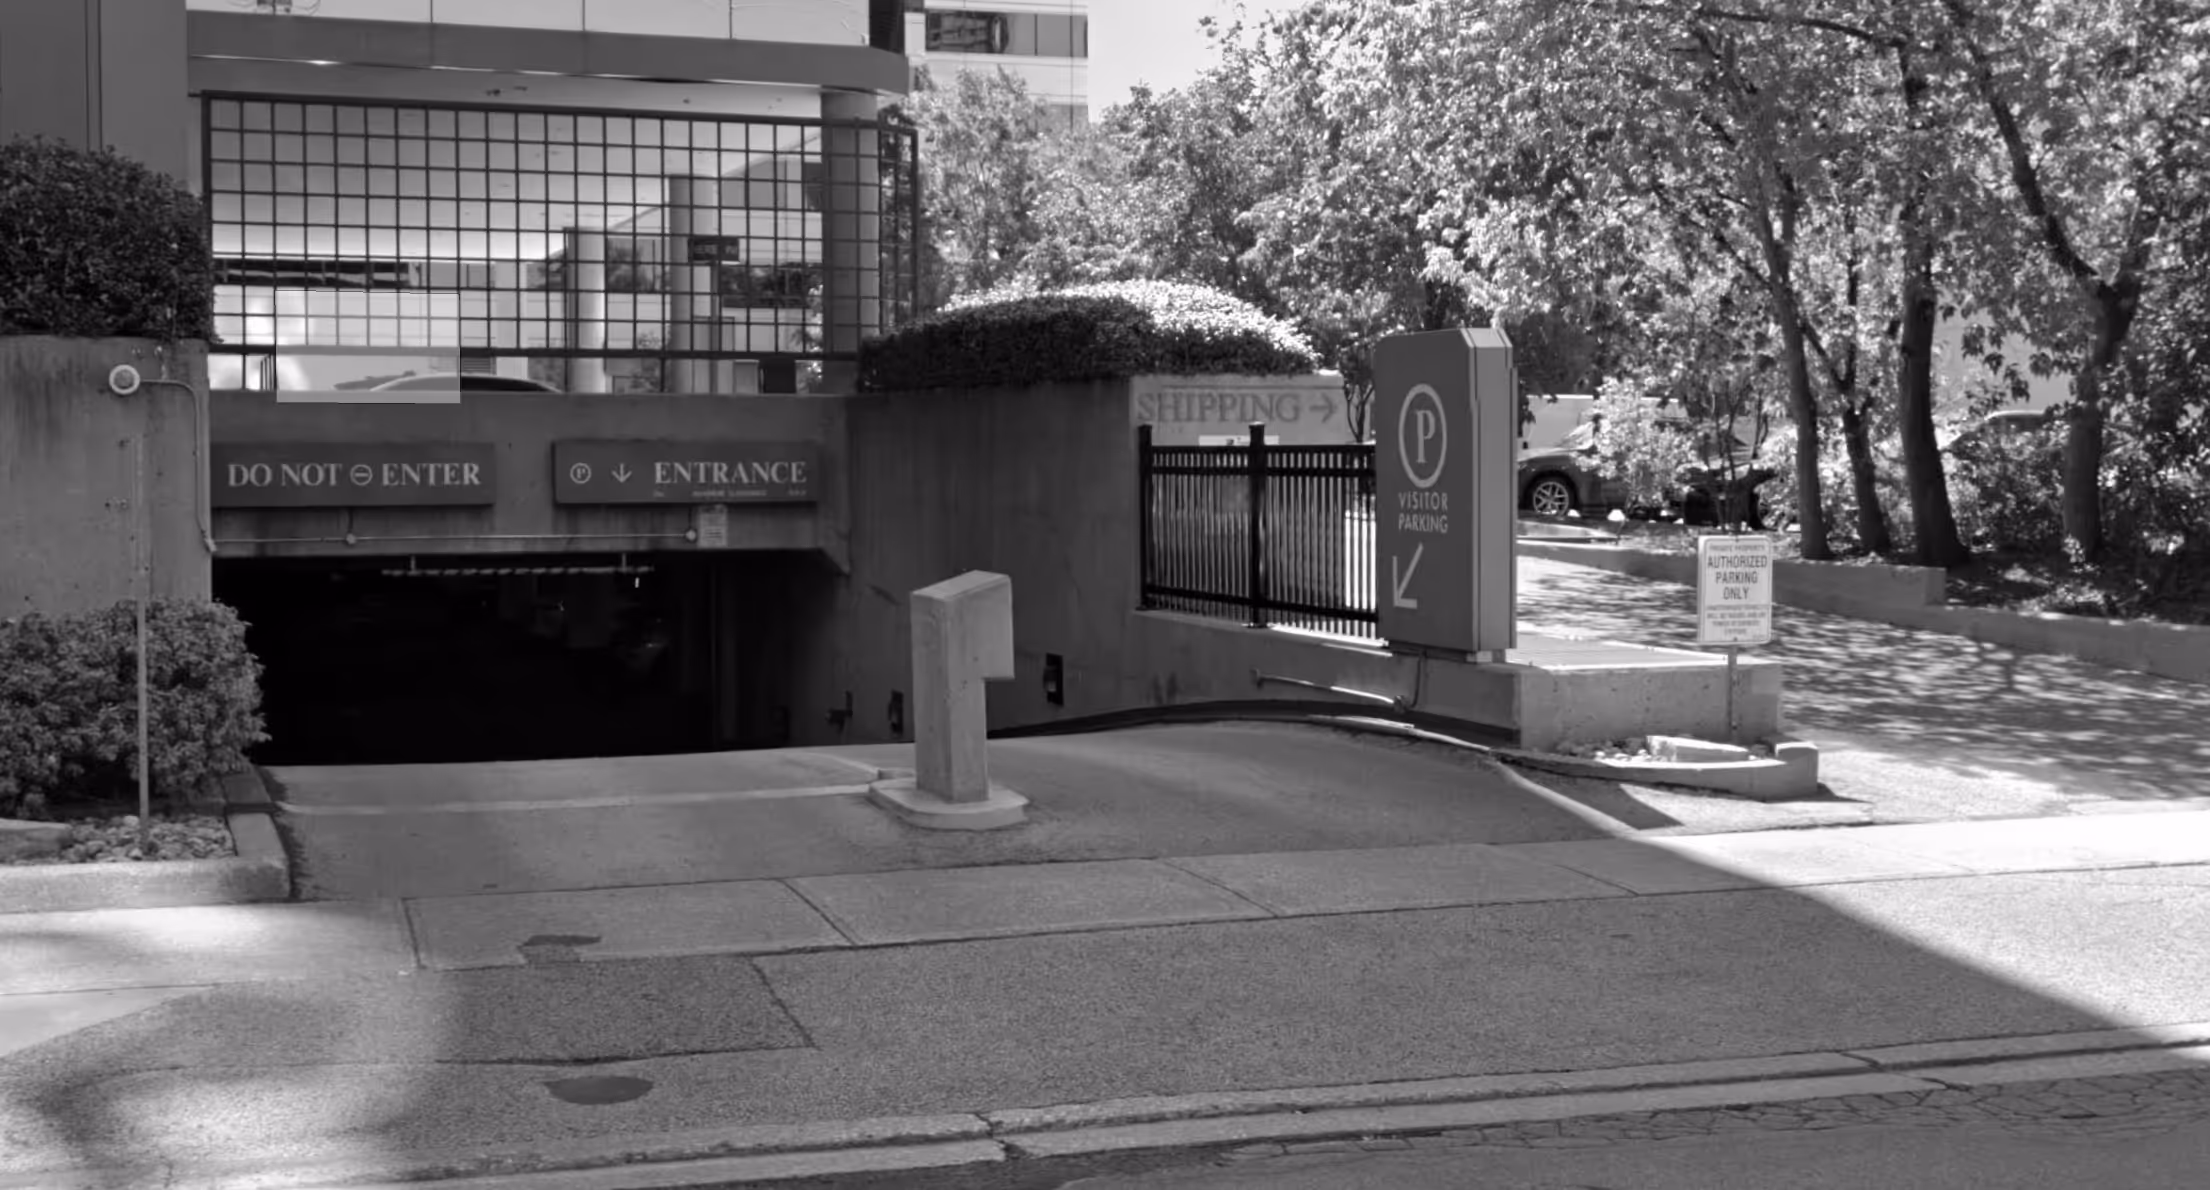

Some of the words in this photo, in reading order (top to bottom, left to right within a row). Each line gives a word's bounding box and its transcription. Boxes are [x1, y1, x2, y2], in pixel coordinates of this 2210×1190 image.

[1137, 392, 1301, 423] SHIPPING
[1415, 409, 1435, 464] P
[228, 463, 272, 487] DO
[281, 463, 342, 487] NOT
[382, 463, 481, 486] ENTER
[654, 462, 807, 484] ENTRANCE
[1398, 491, 1448, 511] VISITOR
[1398, 513, 1448, 534] PARKING
[1708, 555, 1768, 569] AUTHORIZED
[1715, 570, 1758, 585] PARKING
[1723, 586, 1750, 600] ONLY
